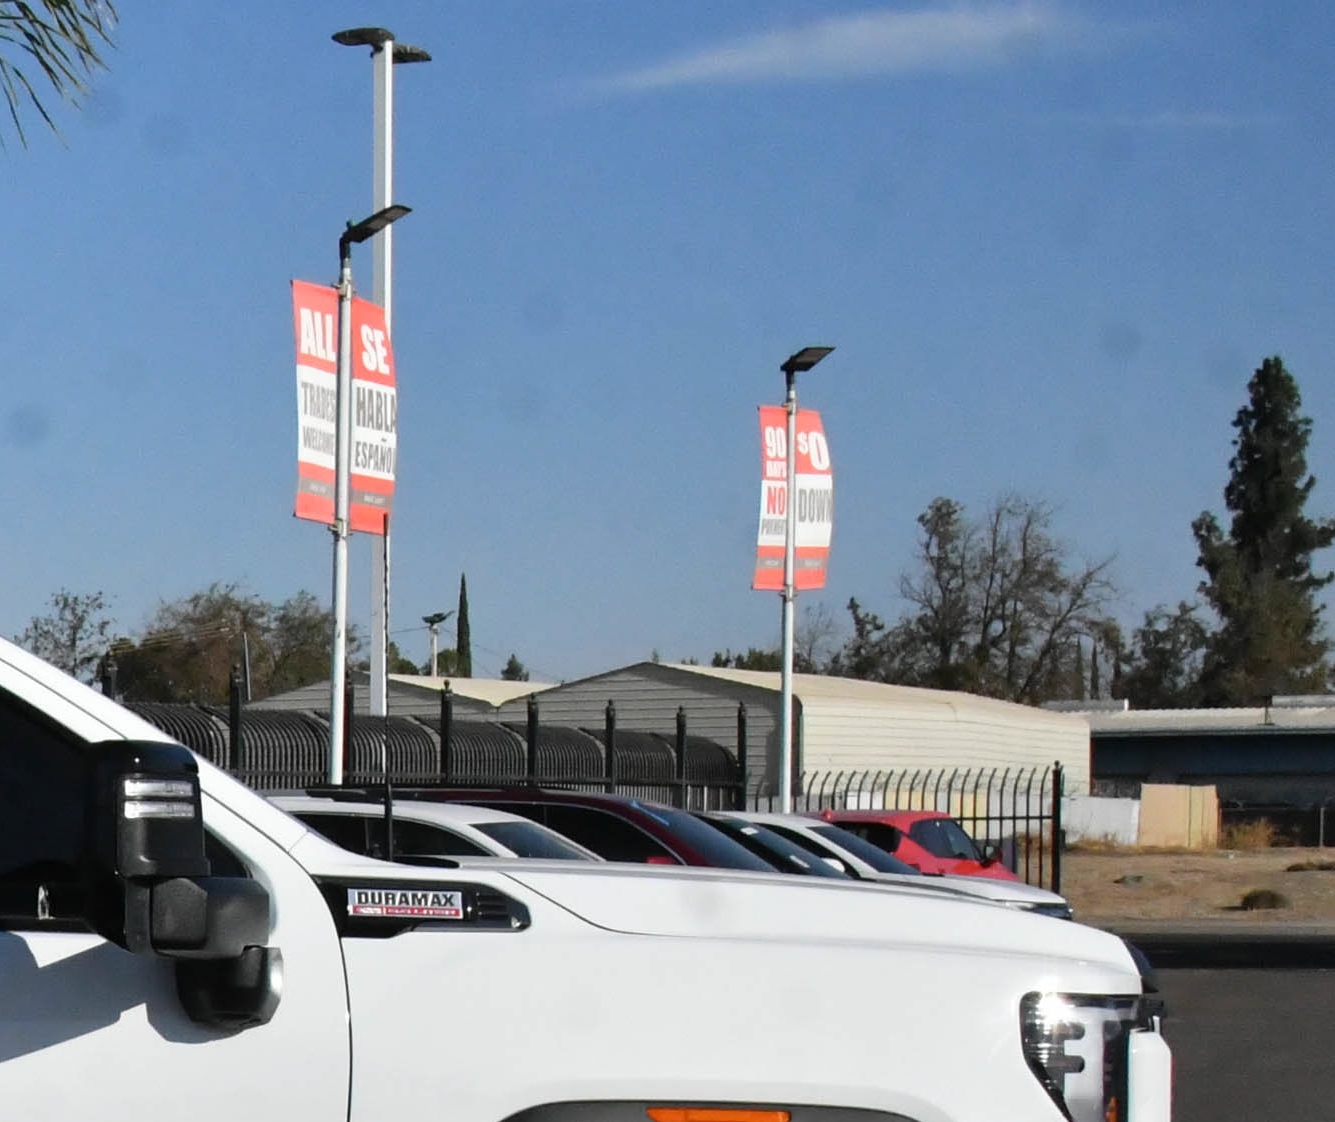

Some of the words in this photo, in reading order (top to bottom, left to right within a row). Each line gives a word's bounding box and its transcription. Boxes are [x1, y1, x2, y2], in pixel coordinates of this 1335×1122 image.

[300, 308, 335, 361] ALL
[361, 324, 390, 375] SE
[356, 387, 395, 433] HABLA
[765, 426, 786, 459] 90
[767, 485, 786, 515] NO
[356, 891, 455, 907] DURAMAX
